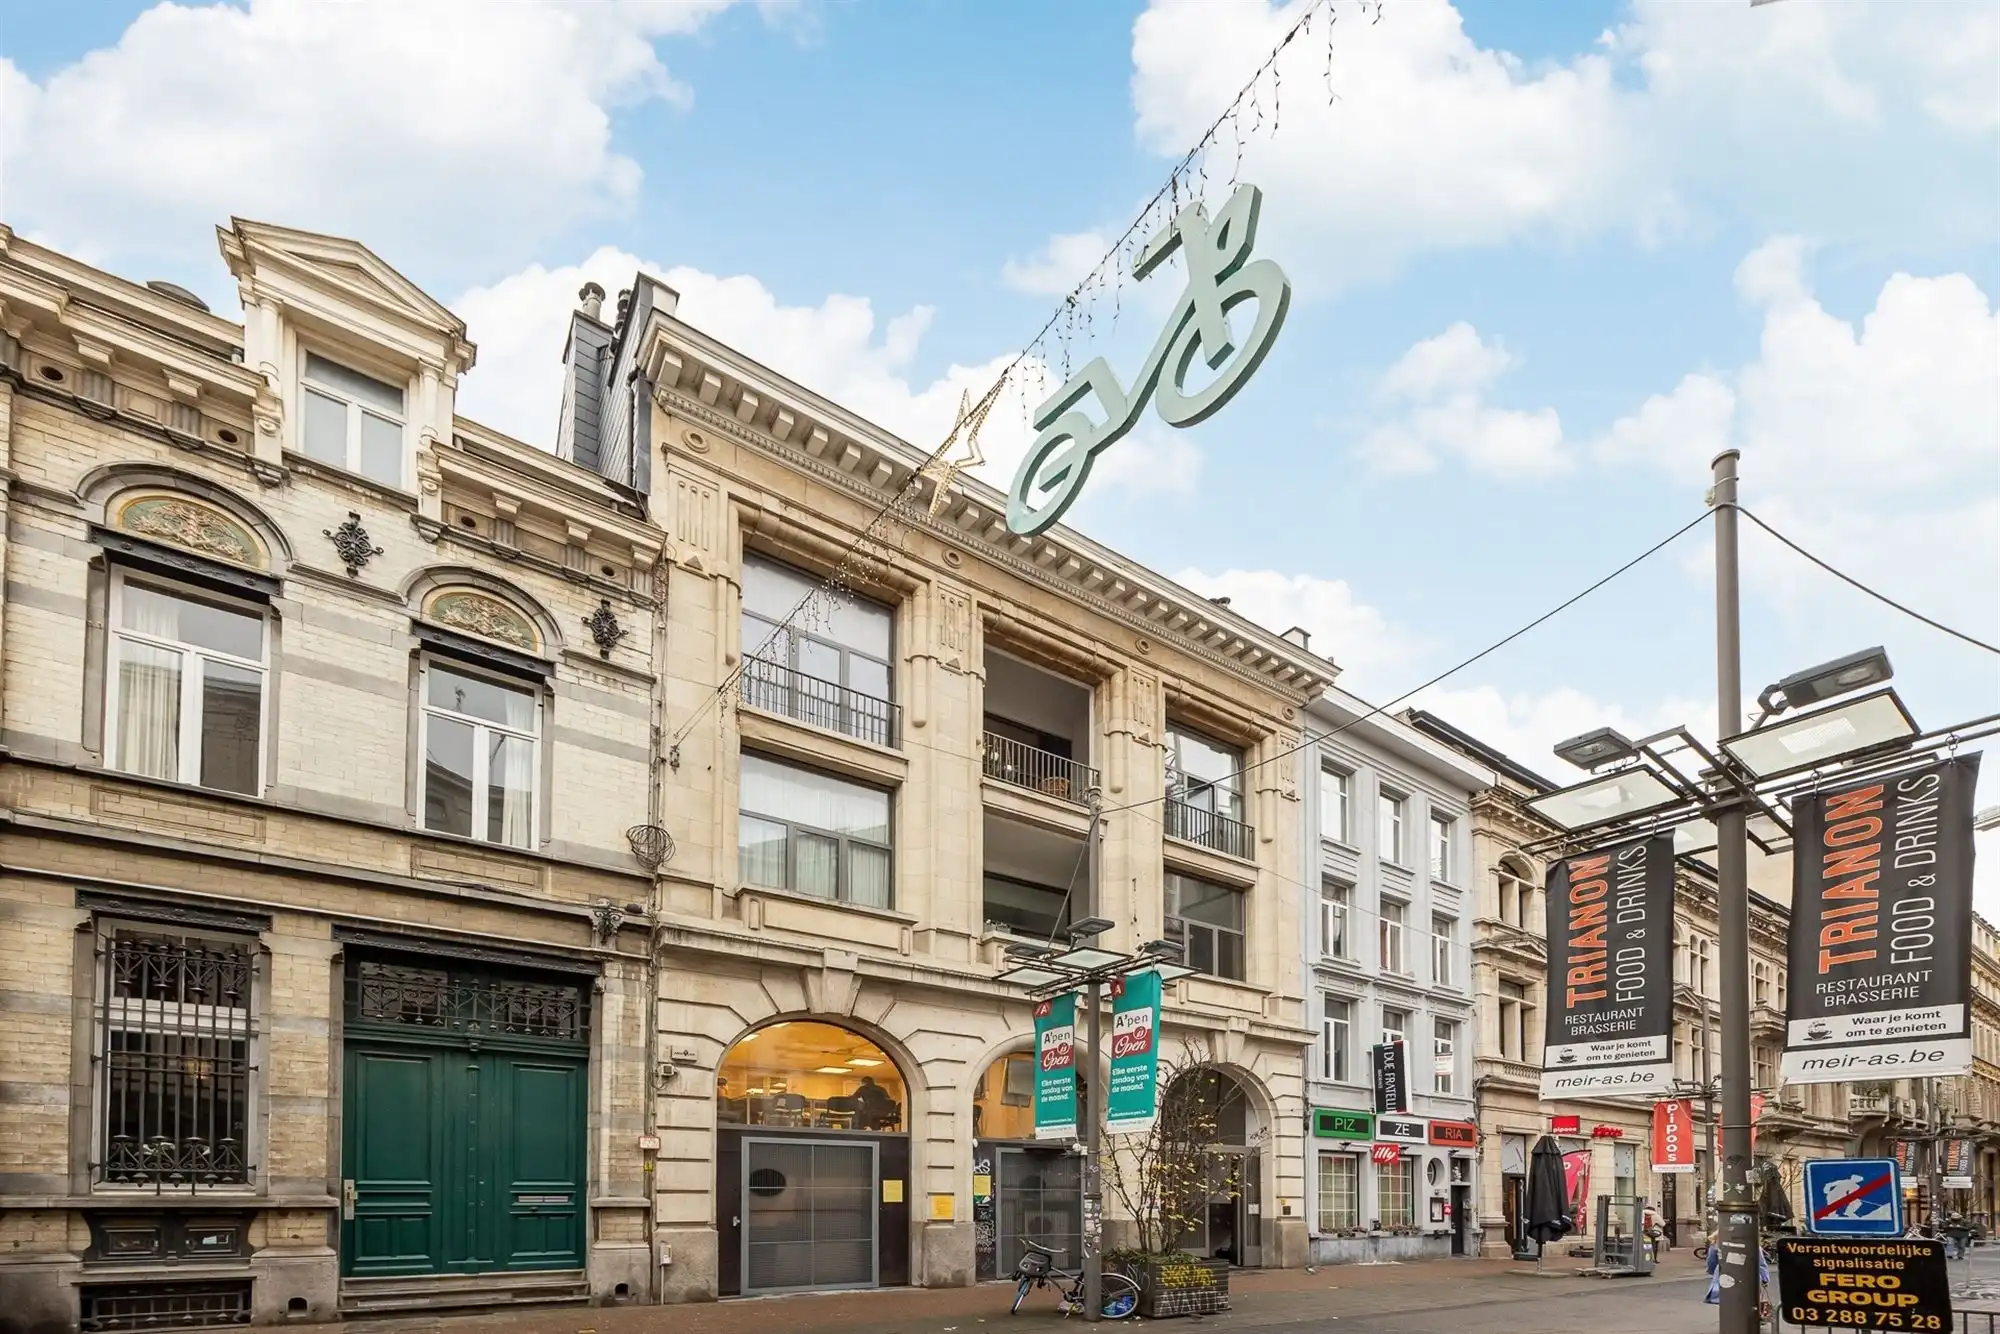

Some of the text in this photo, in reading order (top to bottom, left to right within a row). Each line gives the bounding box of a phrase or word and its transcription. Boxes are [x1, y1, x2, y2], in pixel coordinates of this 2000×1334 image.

[1891, 774, 1940, 964] FOOD & DRINKS
[1818, 784, 1884, 974] TRIANON
[1567, 855, 1611, 1008] TRIANON
[1616, 845, 1646, 1002] FOOD & DRINKS
[1816, 970, 1933, 994] RESTAURANT
[1825, 986, 1919, 1007] BRASSERIE
[1565, 1007, 1645, 1025] RESTAURANT
[1852, 1010, 1941, 1025] Waar je komt
[1570, 1020, 1636, 1036] BRASSERIE
[1846, 1022, 1947, 1038] om te genieten
[1115, 1036, 1146, 1058] Open
[1590, 1040, 1651, 1052] Waar je komt
[1043, 1050, 1070, 1071] Open
[1384, 1052, 1395, 1070] DUE
[1586, 1051, 1656, 1062] om te genieten
[1802, 1050, 1945, 1071] meir-as.be
[1126, 1064, 1148, 1074] eerste
[1555, 1072, 1654, 1088] meir-as.be
[1384, 1073, 1396, 1110] FRATELLI
[1334, 1117, 1355, 1131] PIZ
[1394, 1123, 1410, 1136] ZE
[1666, 1103, 1678, 1162] pipoos
[1445, 1127, 1464, 1140] RIA
[1374, 1146, 1396, 1162] illy
[1787, 1242, 1932, 1258] Verantwoordelijke
[1813, 1258, 1905, 1270] signalisatie
[1819, 1273, 1901, 1289] FERO
[1807, 1289, 1919, 1308] GROUP
[1792, 1307, 1941, 1329] 03 288 75 28
